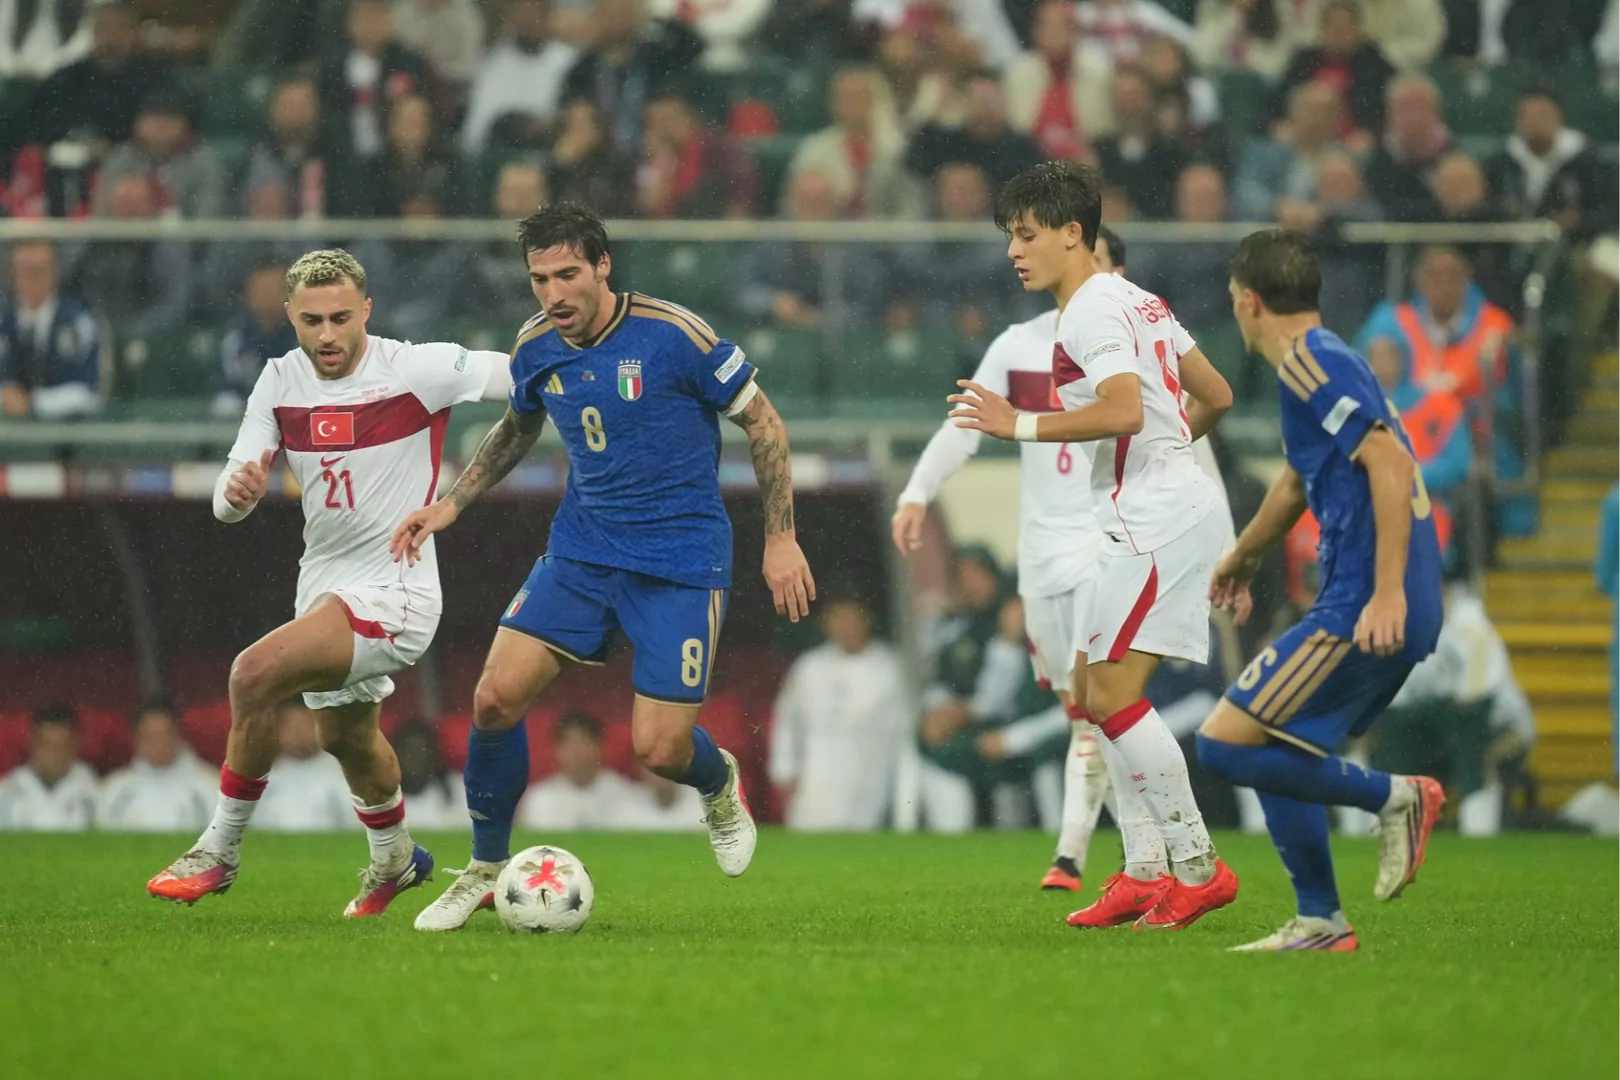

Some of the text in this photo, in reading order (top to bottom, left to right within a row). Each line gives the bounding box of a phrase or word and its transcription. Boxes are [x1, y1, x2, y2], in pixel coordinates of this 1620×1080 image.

[581, 406, 607, 452] 8
[1057, 440, 1072, 475] 6
[323, 469, 355, 509] 21
[681, 638, 704, 687] 8
[1237, 646, 1277, 691] 6
